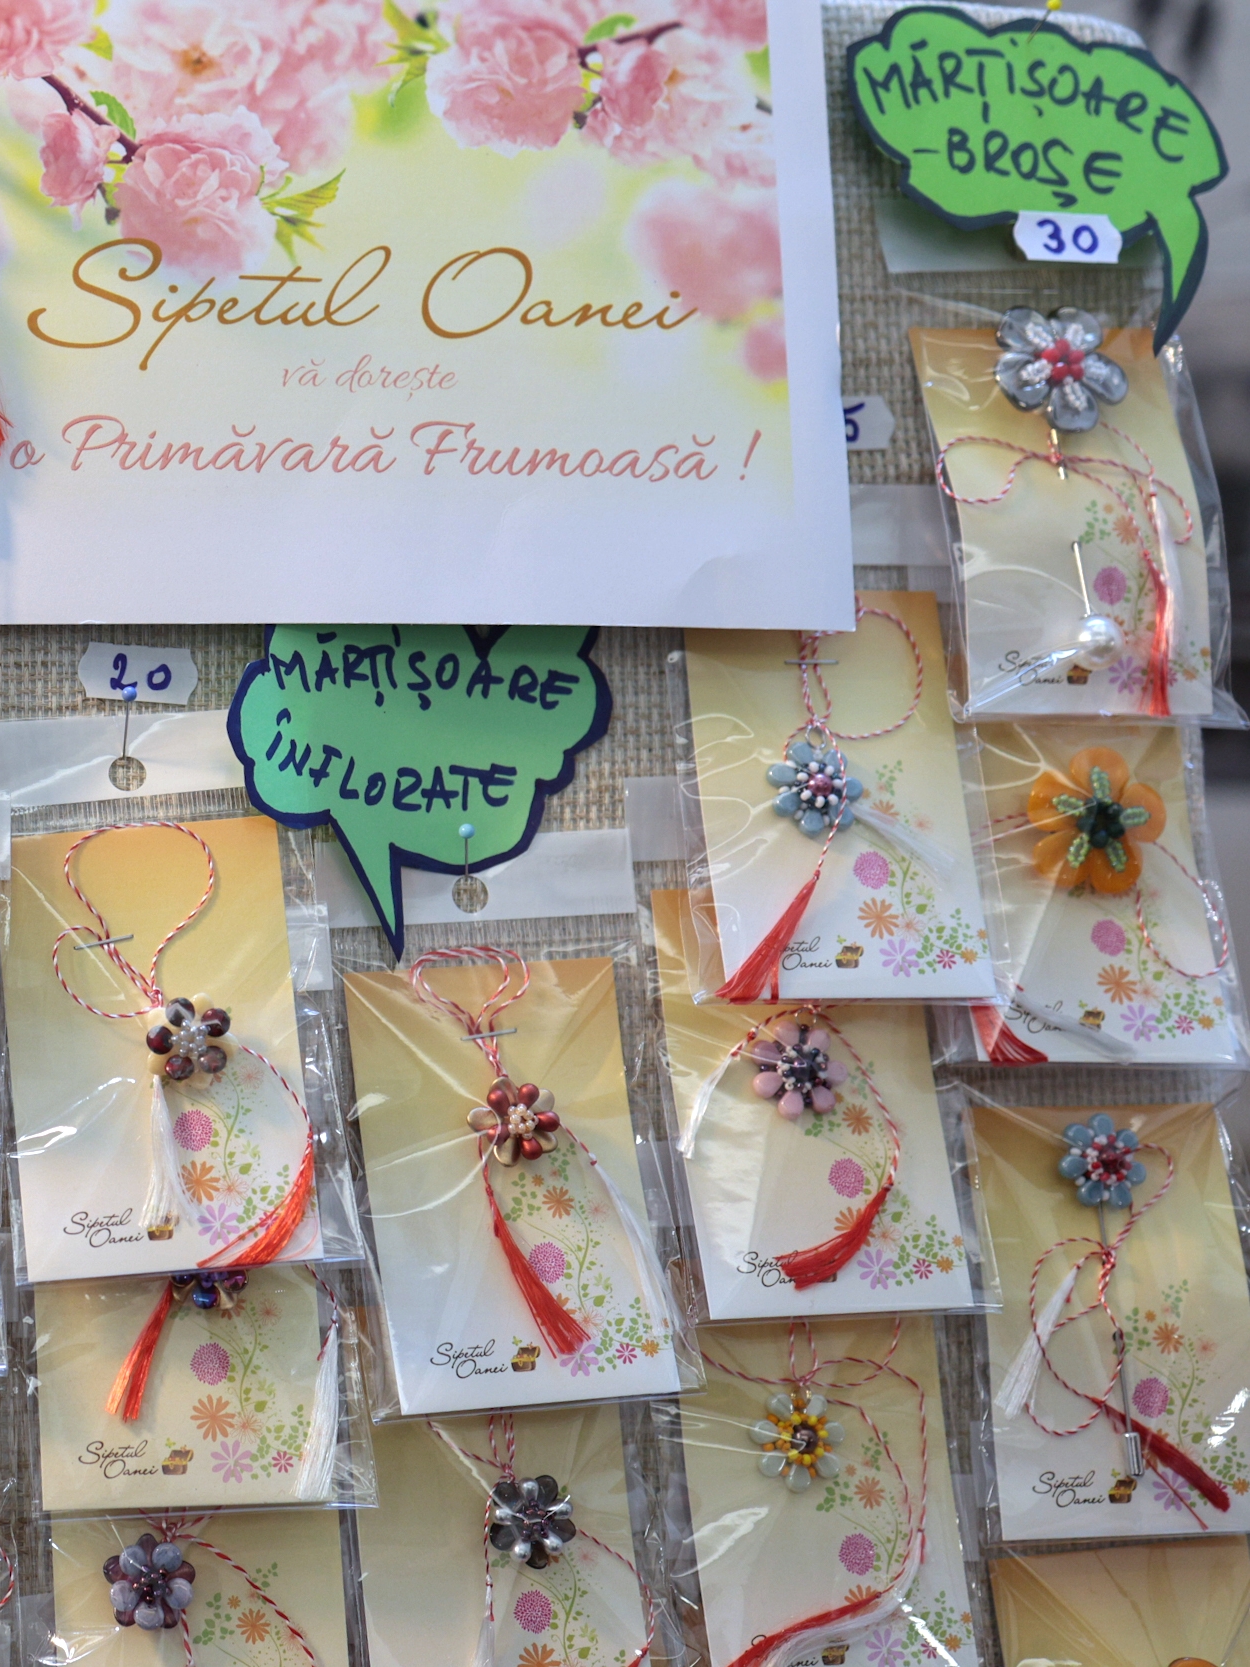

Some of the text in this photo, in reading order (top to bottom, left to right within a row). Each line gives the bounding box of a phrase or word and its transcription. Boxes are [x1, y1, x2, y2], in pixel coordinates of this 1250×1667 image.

[1036, 218, 1100, 254] 30
[26, 238, 699, 372] Sipetul Oanei
[282, 354, 459, 401] vă dorește
[9, 439, 46, 470] o
[61, 414, 397, 473] Primăvară
[410, 420, 718, 482] Frumoasă
[110, 651, 173, 691] 20
[265, 707, 518, 812] ÎNFLORATE
[782, 952, 833, 971] Oanei
[63, 1208, 134, 1238] Sipetul
[89, 1228, 145, 1249] Oanei
[761, 1268, 797, 1288] Oan
[430, 1339, 496, 1369] Sipetul
[455, 1358, 509, 1379] Oanei
[78, 1439, 148, 1468] Sipetul
[103, 1459, 159, 1479] Oanei
[1032, 1470, 1096, 1499] Sipetul
[1055, 1488, 1106, 1508] Oanei
